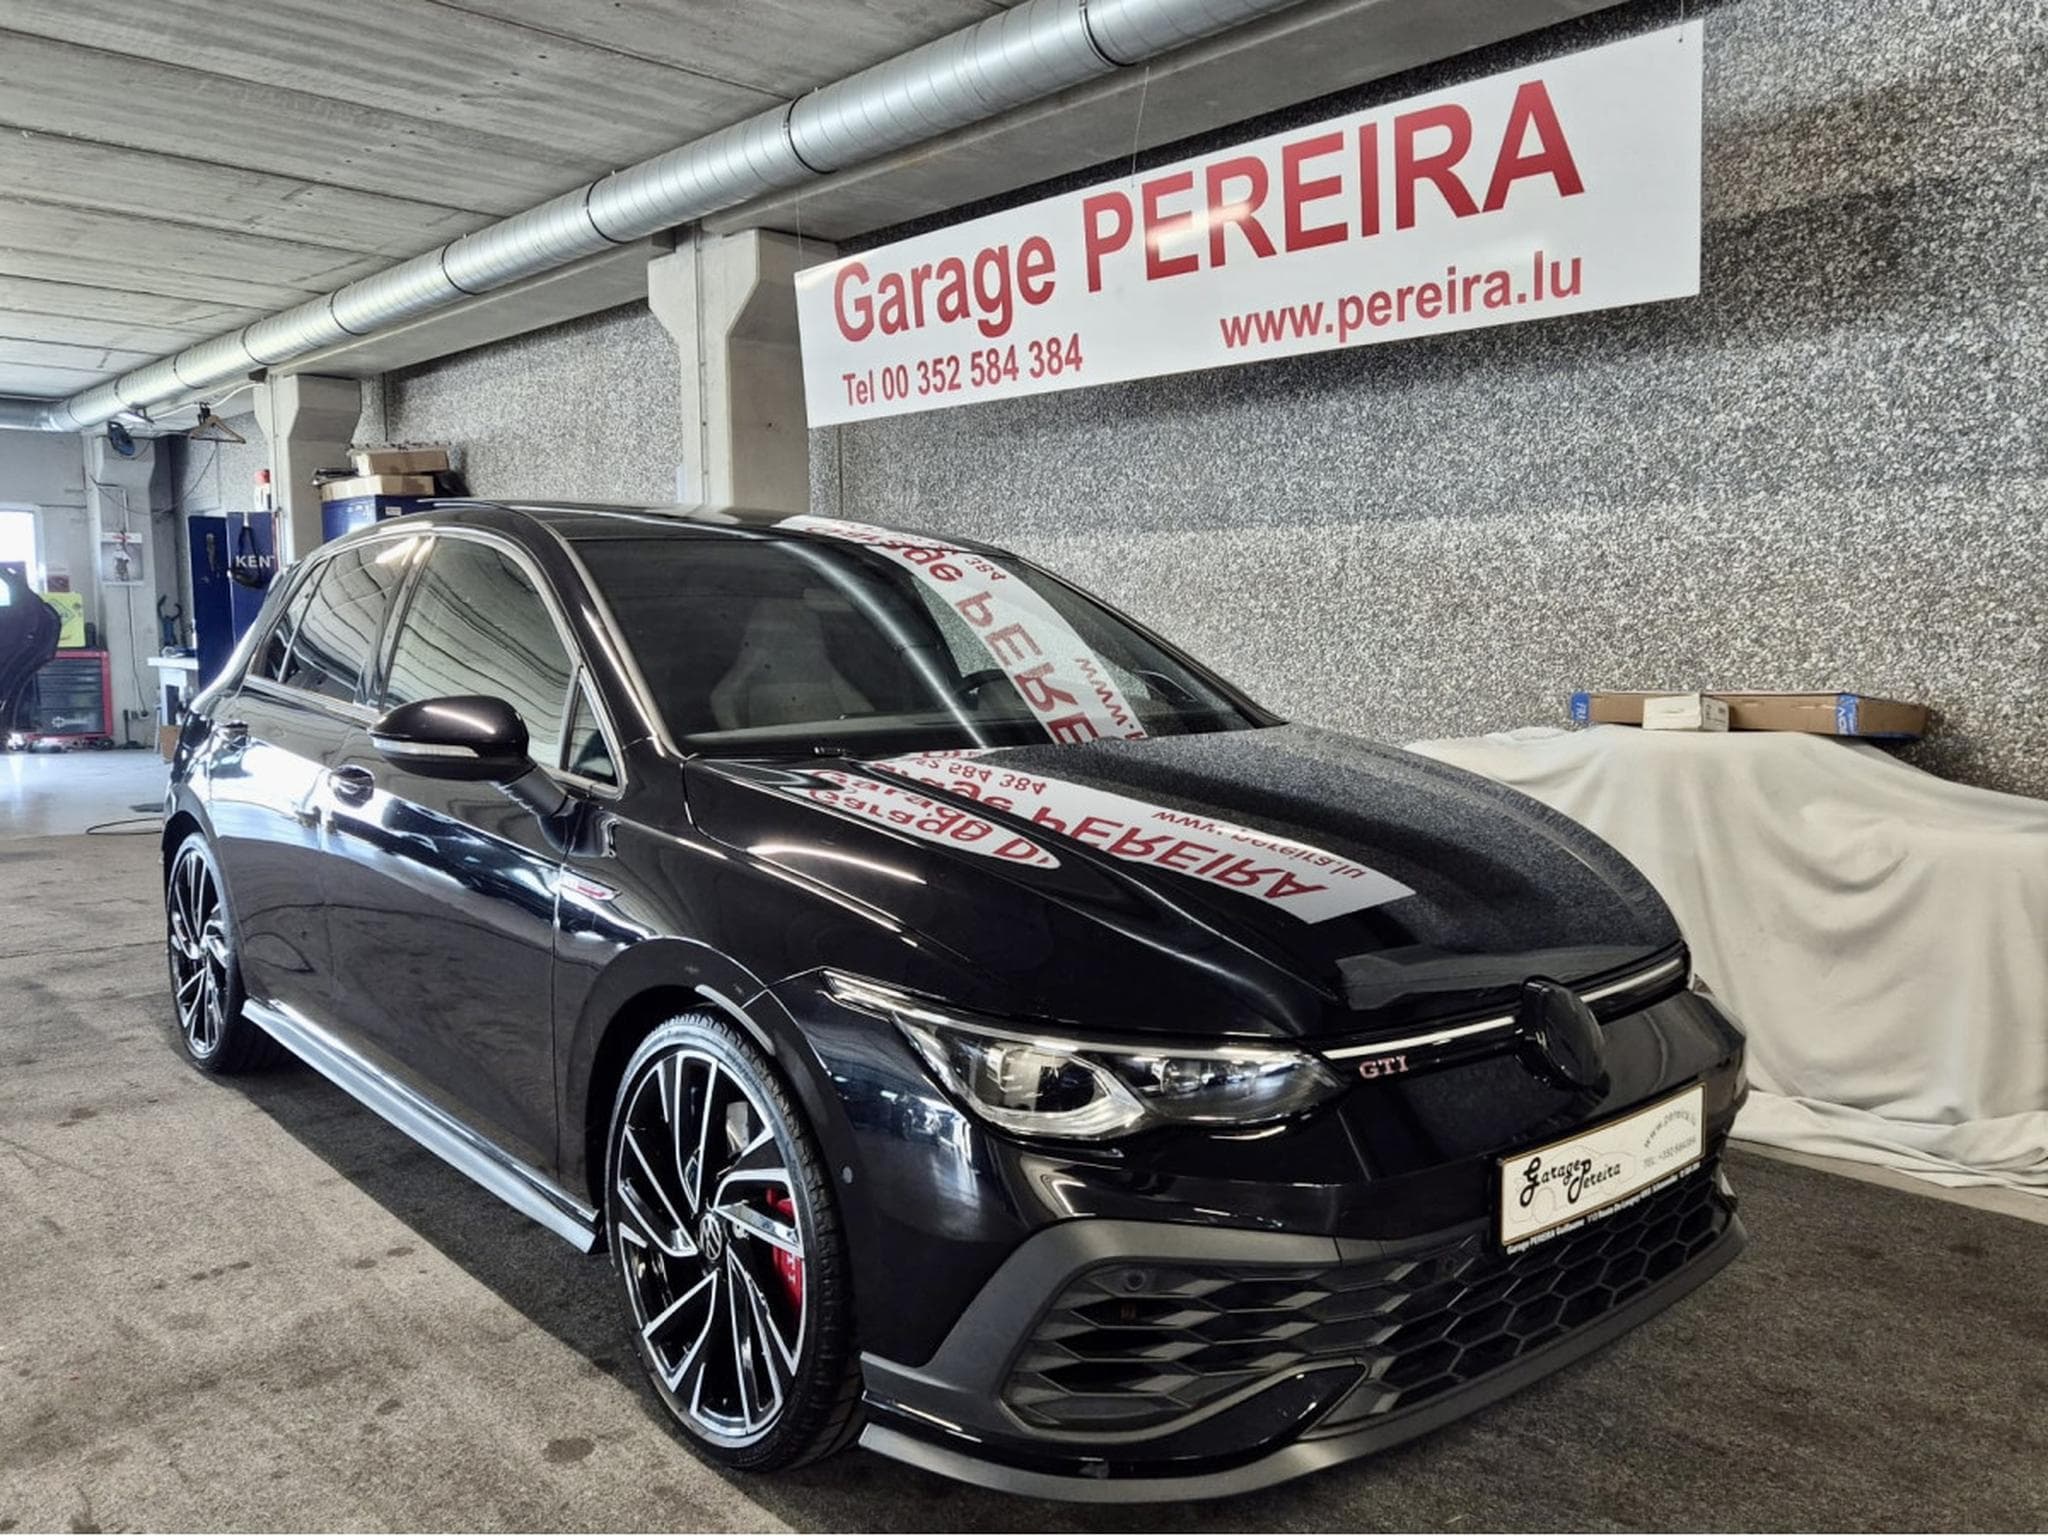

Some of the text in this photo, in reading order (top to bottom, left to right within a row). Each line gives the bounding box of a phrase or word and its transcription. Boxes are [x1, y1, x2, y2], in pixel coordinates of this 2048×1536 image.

[834, 79, 1585, 342] Garage PEREIRA
[1220, 250, 1583, 350] www.pereira.lu
[842, 333, 1083, 406] Tel 00 352 584 384
[1359, 1055, 1409, 1079] GTI
[1519, 1156, 1621, 1207] Garage Pereira
